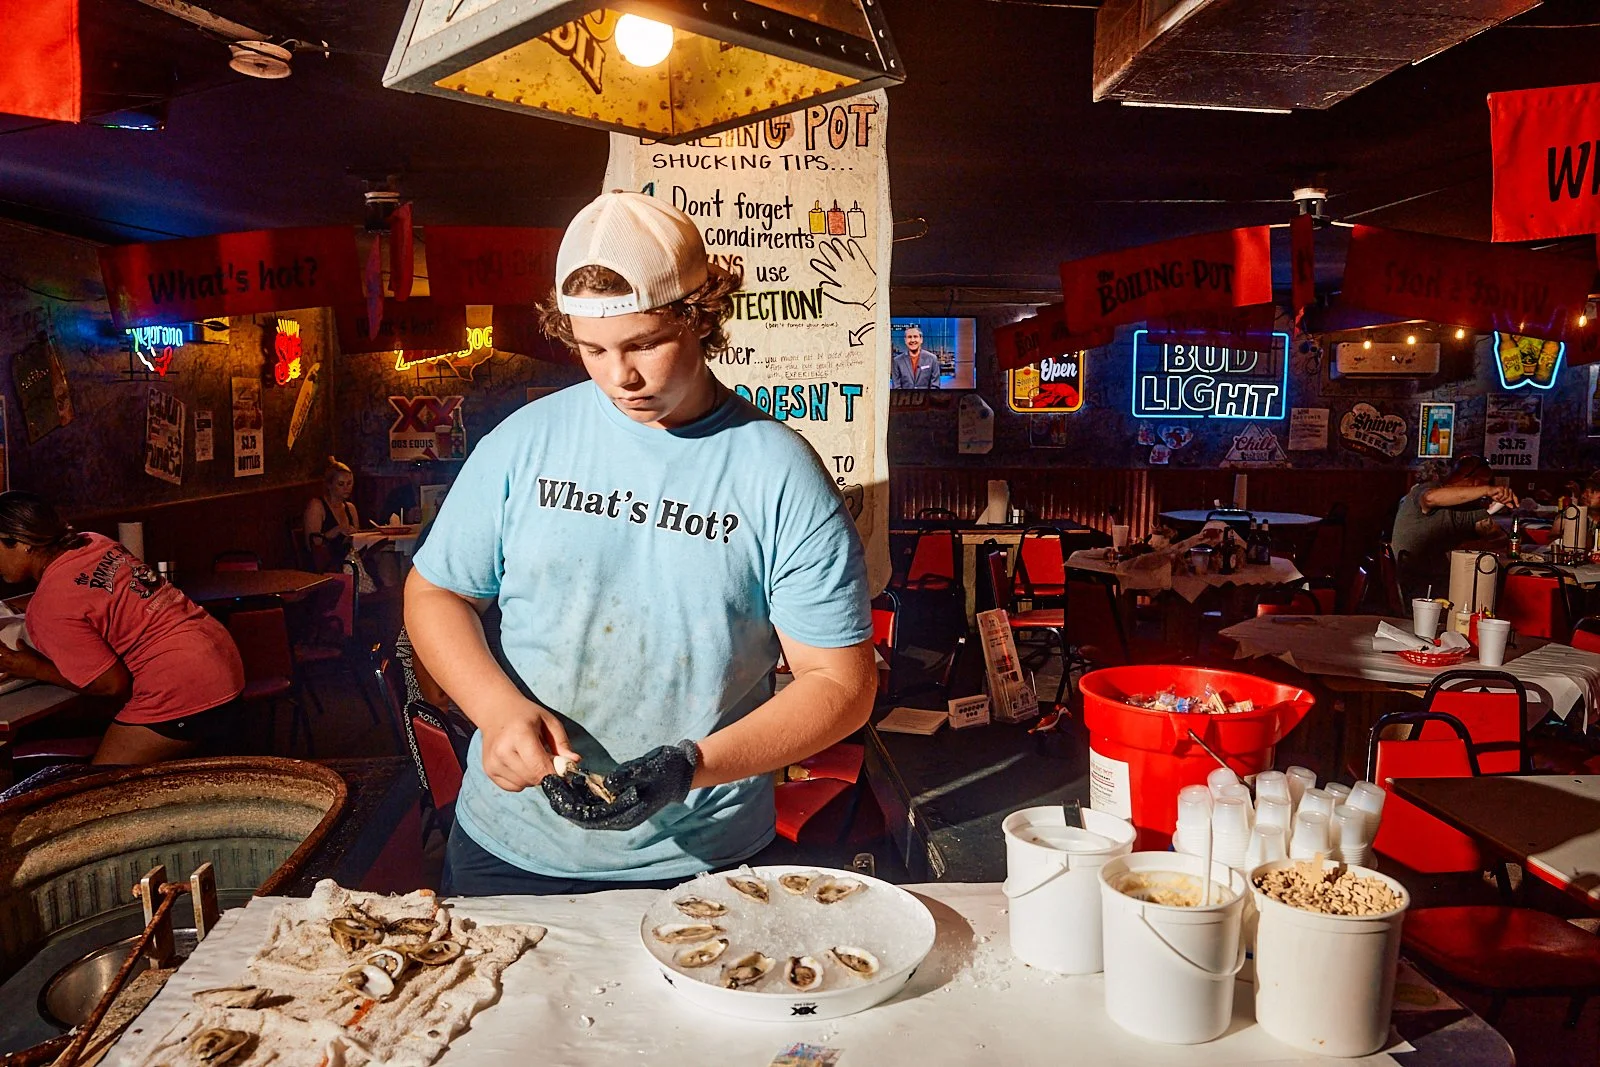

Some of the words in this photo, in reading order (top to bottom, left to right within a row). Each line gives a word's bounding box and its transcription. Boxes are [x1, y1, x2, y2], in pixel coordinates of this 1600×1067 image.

[805, 103, 879, 151] POT
[652, 153, 772, 171] SHUCKING
[780, 153, 854, 171] TIPS...
[672, 185, 724, 218] Don't
[734, 191, 794, 231] forget
[704, 225, 815, 250] condiments
[148, 261, 250, 305] What's
[258, 256, 318, 291] hot?
[756, 265, 790, 282] use
[1097, 260, 1184, 316] BOILING
[1192, 258, 1234, 294] POT
[732, 287, 823, 320] TECTION!
[1041, 357, 1078, 381] Open
[1164, 343, 1258, 373] BUD
[1142, 374, 1279, 417] LIGHT
[1350, 411, 1403, 433] Shiner
[1234, 436, 1275, 450] Chill
[1355, 431, 1389, 450] BEERS
[1498, 437, 1527, 450] $3.75
[1490, 453, 1532, 466] BOTTLES
[538, 478, 650, 524] What's
[656, 499, 740, 544] Hot?
